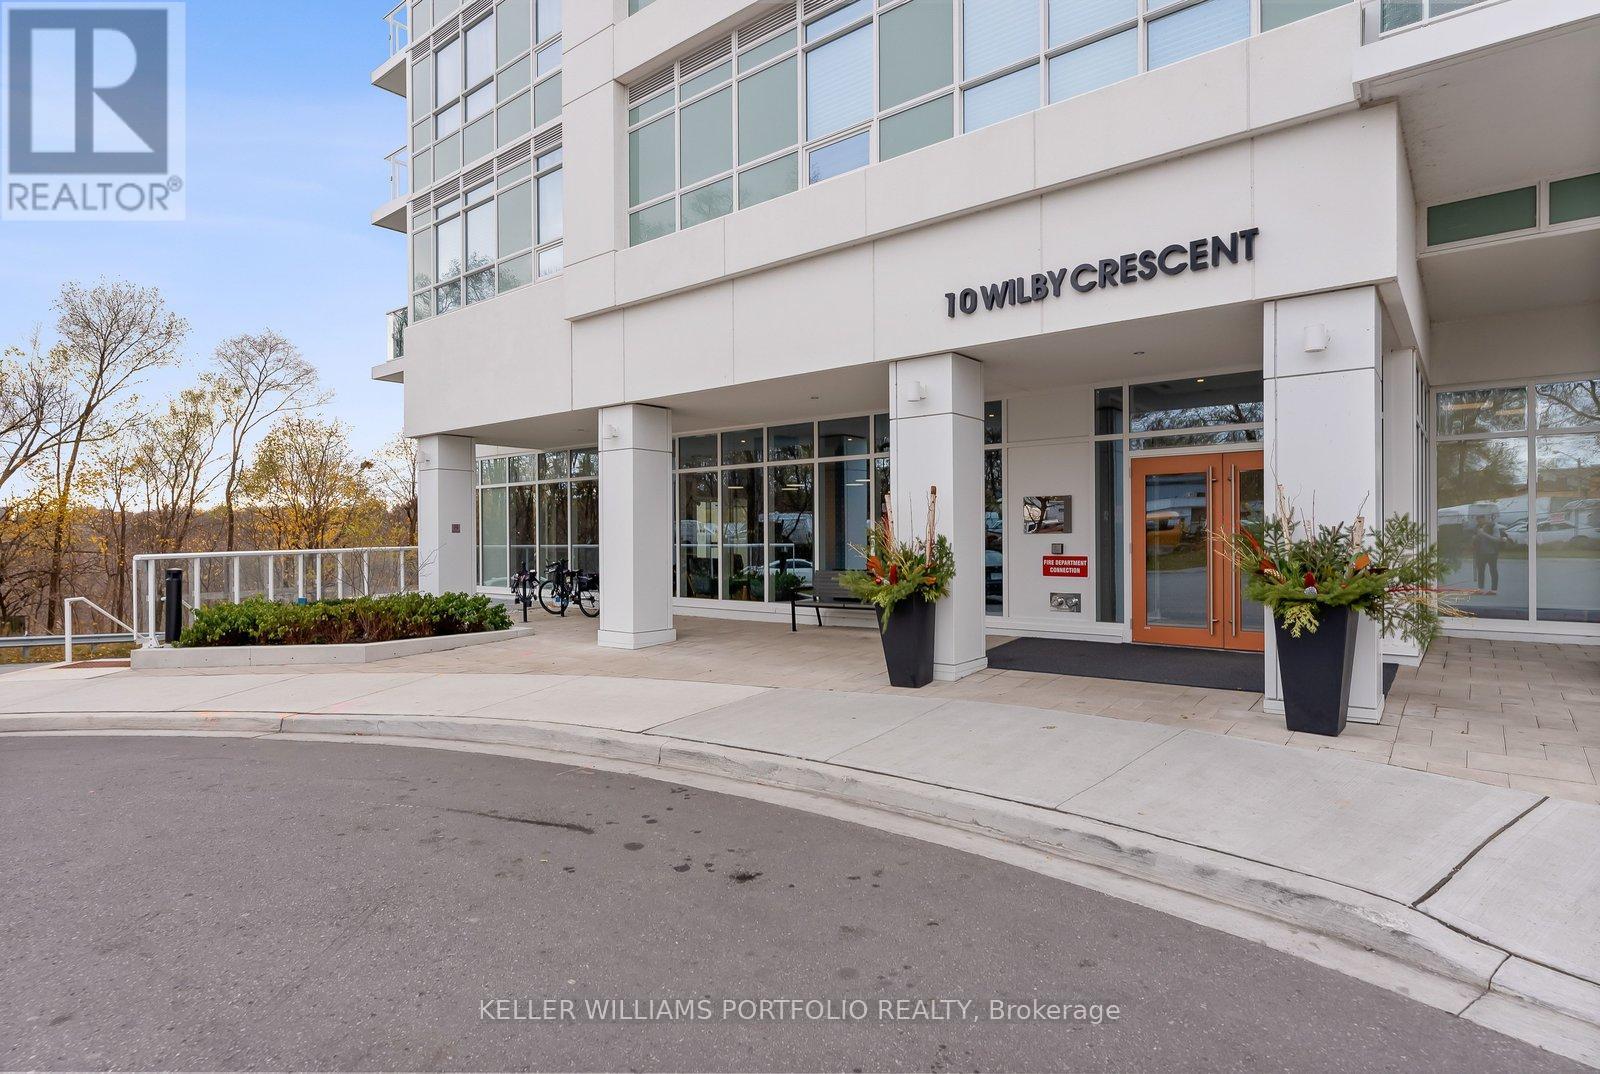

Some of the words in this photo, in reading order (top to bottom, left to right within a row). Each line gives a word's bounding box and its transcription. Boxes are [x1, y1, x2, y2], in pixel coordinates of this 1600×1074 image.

[944, 287, 977, 319] 10
[979, 267, 1068, 311] WILBY
[1069, 227, 1260, 293] CRESCENT
